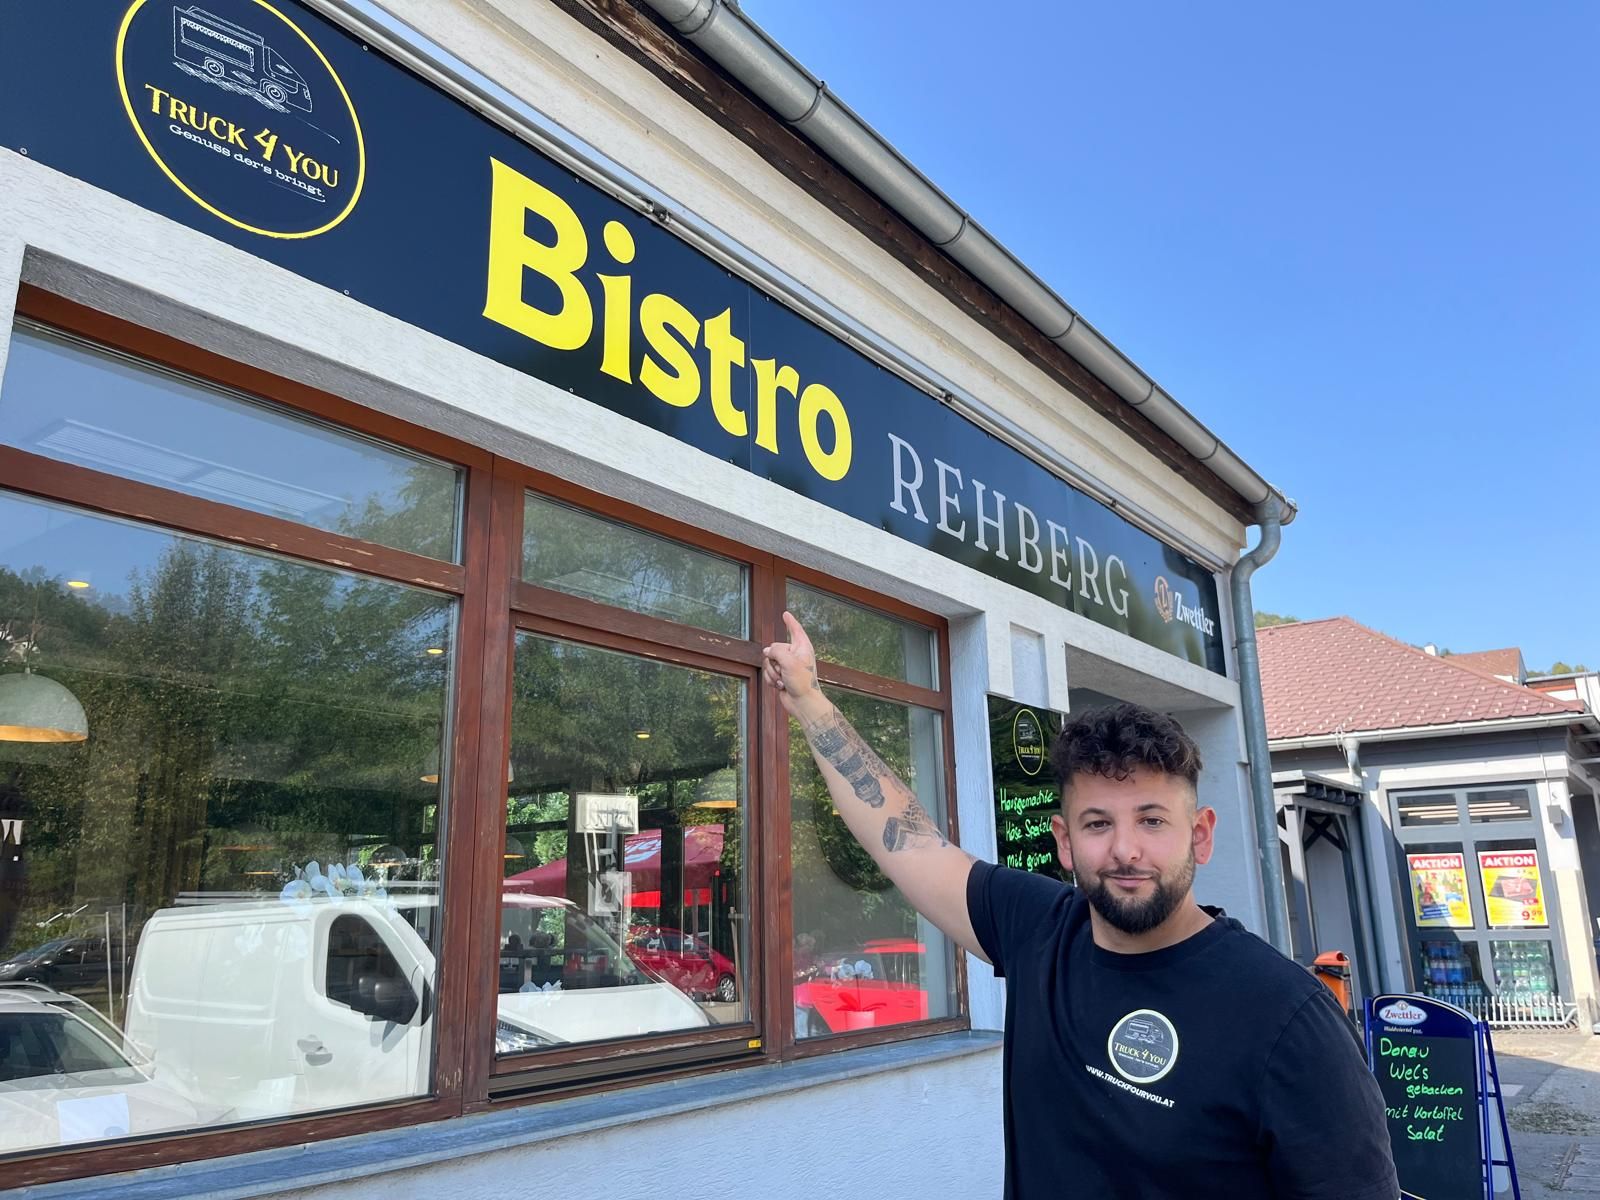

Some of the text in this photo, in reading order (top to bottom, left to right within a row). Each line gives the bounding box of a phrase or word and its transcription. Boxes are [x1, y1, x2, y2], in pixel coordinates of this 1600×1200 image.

[145, 84, 339, 188] TRUCK 4 YOU
[169, 124, 326, 198] Genuss der's bringt.
[482, 156, 852, 481] Bistro
[888, 432, 1129, 618] REHBERG
[1174, 591, 1215, 637] Zwettler
[1412, 857, 1460, 869] AKTION
[1484, 855, 1534, 867] AKTION
[1384, 1009, 1422, 1020] Zwettler
[1114, 1041, 1140, 1058] TRUCK
[1142, 1048, 1150, 1060] 4
[1149, 1053, 1167, 1066] YOU
[1380, 1037, 1429, 1058] Donau
[1389, 1062, 1429, 1081] Wels
[1085, 1064, 1175, 1108] WWW.TRUCKFOURYOU.AT
[1406, 1083, 1464, 1099] gebacken
[1385, 1104, 1409, 1119] mit
[1407, 1124, 1445, 1142] Salat
